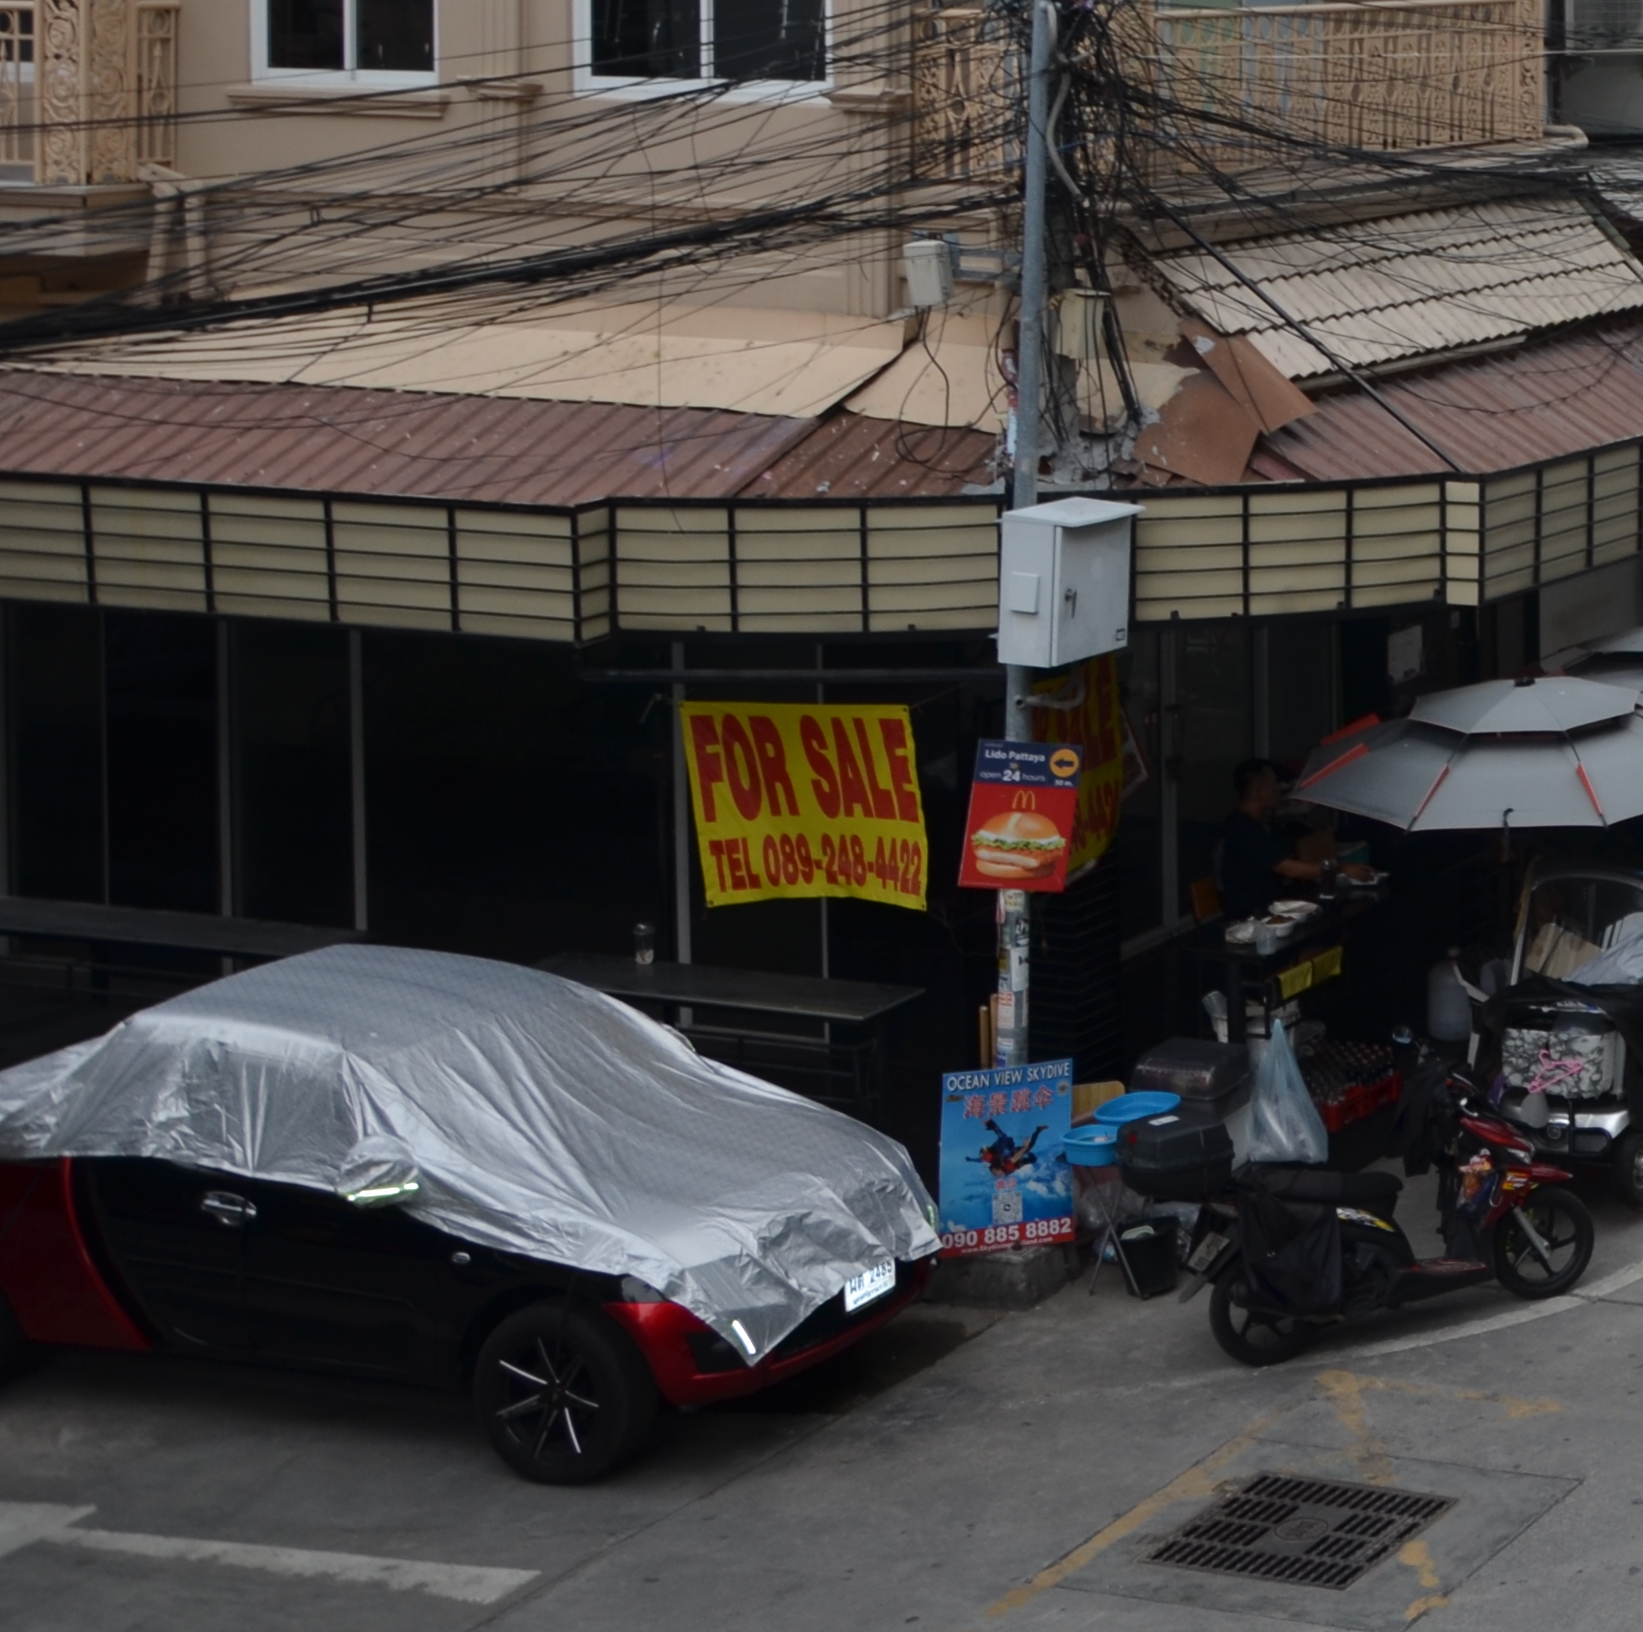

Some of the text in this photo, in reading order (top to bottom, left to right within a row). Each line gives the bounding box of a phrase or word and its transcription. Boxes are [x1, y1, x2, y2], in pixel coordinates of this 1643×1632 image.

[690, 713, 800, 823] FOR
[800, 714, 920, 824] SALE
[985, 749, 1045, 764] Lido Pattaya
[980, 770, 1045, 782] open 24 hours
[708, 833, 922, 896] TEL 089-248-4422
[947, 1062, 1070, 1091] OCEAN VIEW SKYDIVE
[943, 1218, 1072, 1249] 090 885 8882
